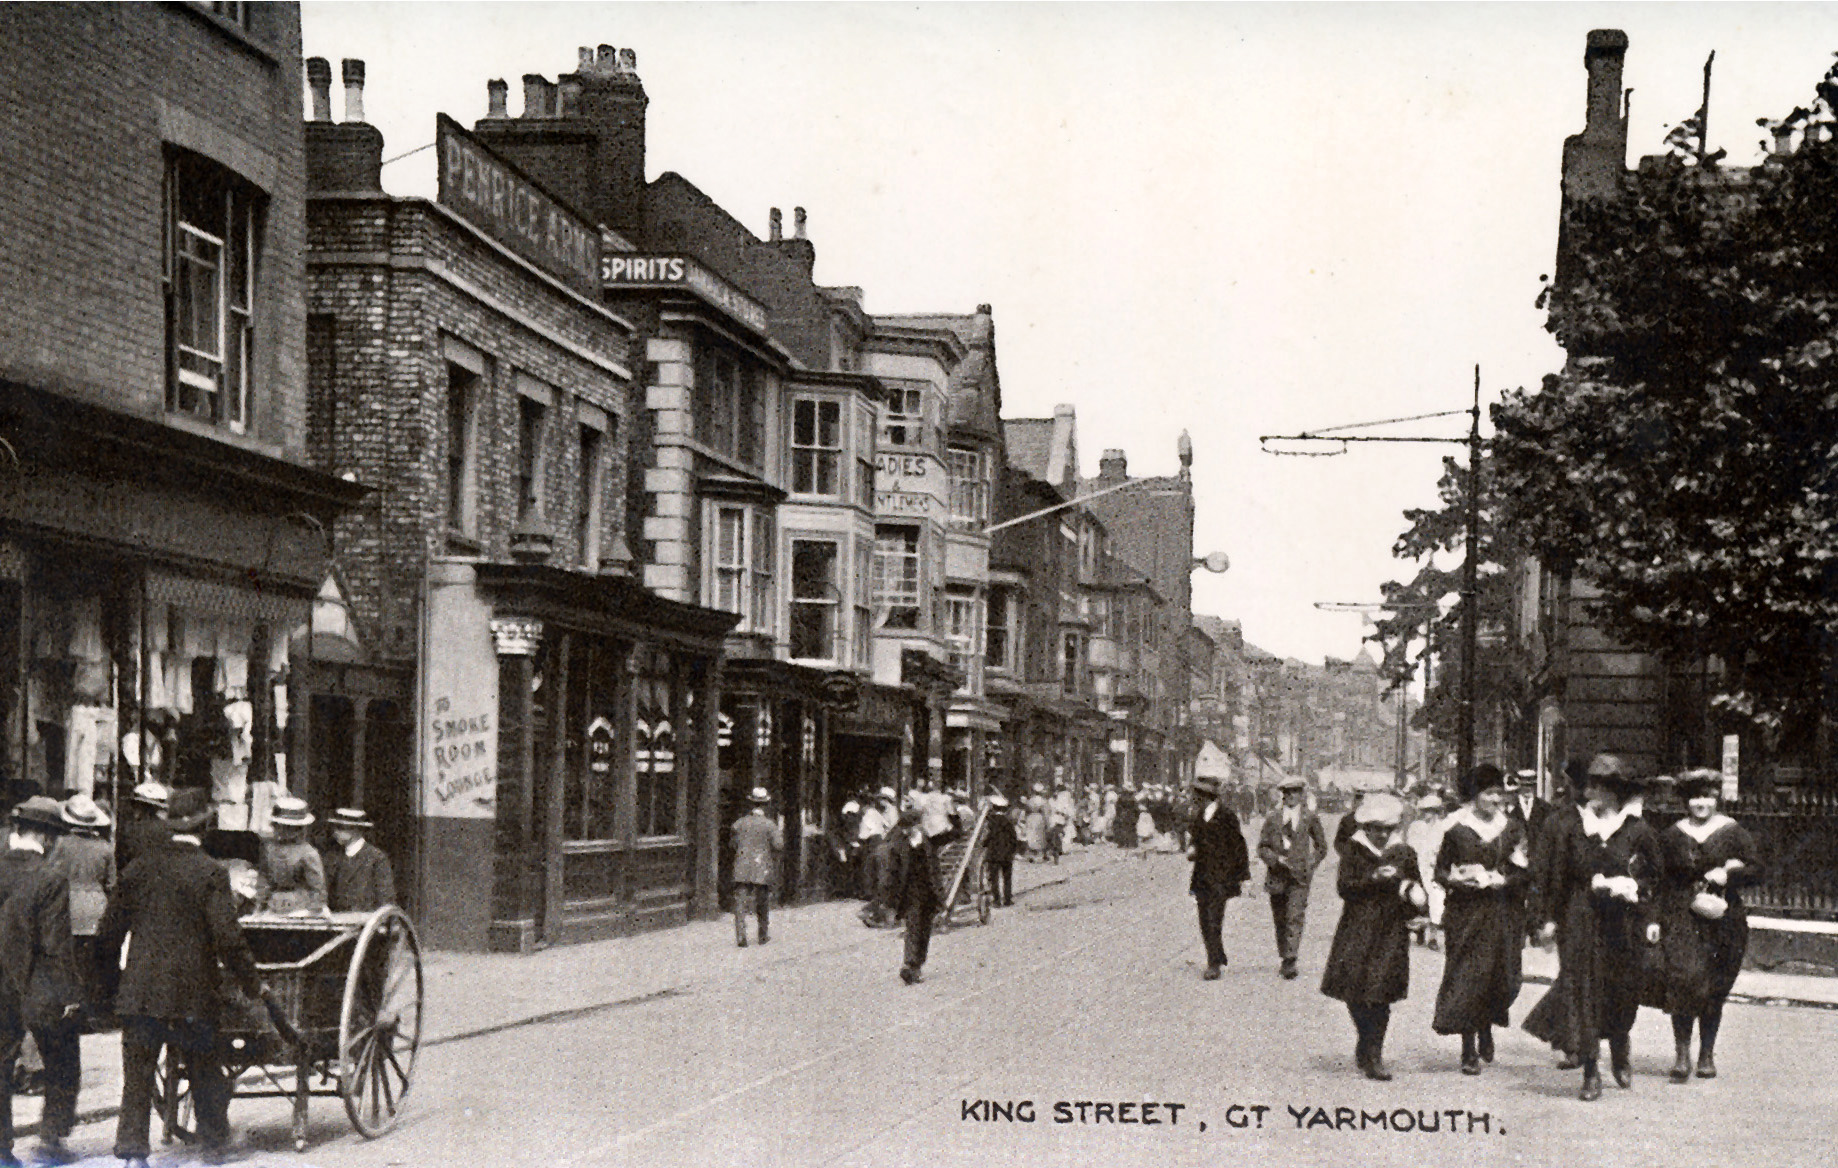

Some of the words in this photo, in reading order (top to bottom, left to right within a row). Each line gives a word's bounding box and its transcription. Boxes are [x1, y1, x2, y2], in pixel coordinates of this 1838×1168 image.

[445, 134, 540, 246] PENRICE
[547, 210, 598, 282] ARMS
[602, 257, 684, 280] SPIRITS
[432, 713, 490, 743] SMOKE
[434, 740, 487, 769] ROOM
[434, 767, 493, 805] LOUNGE
